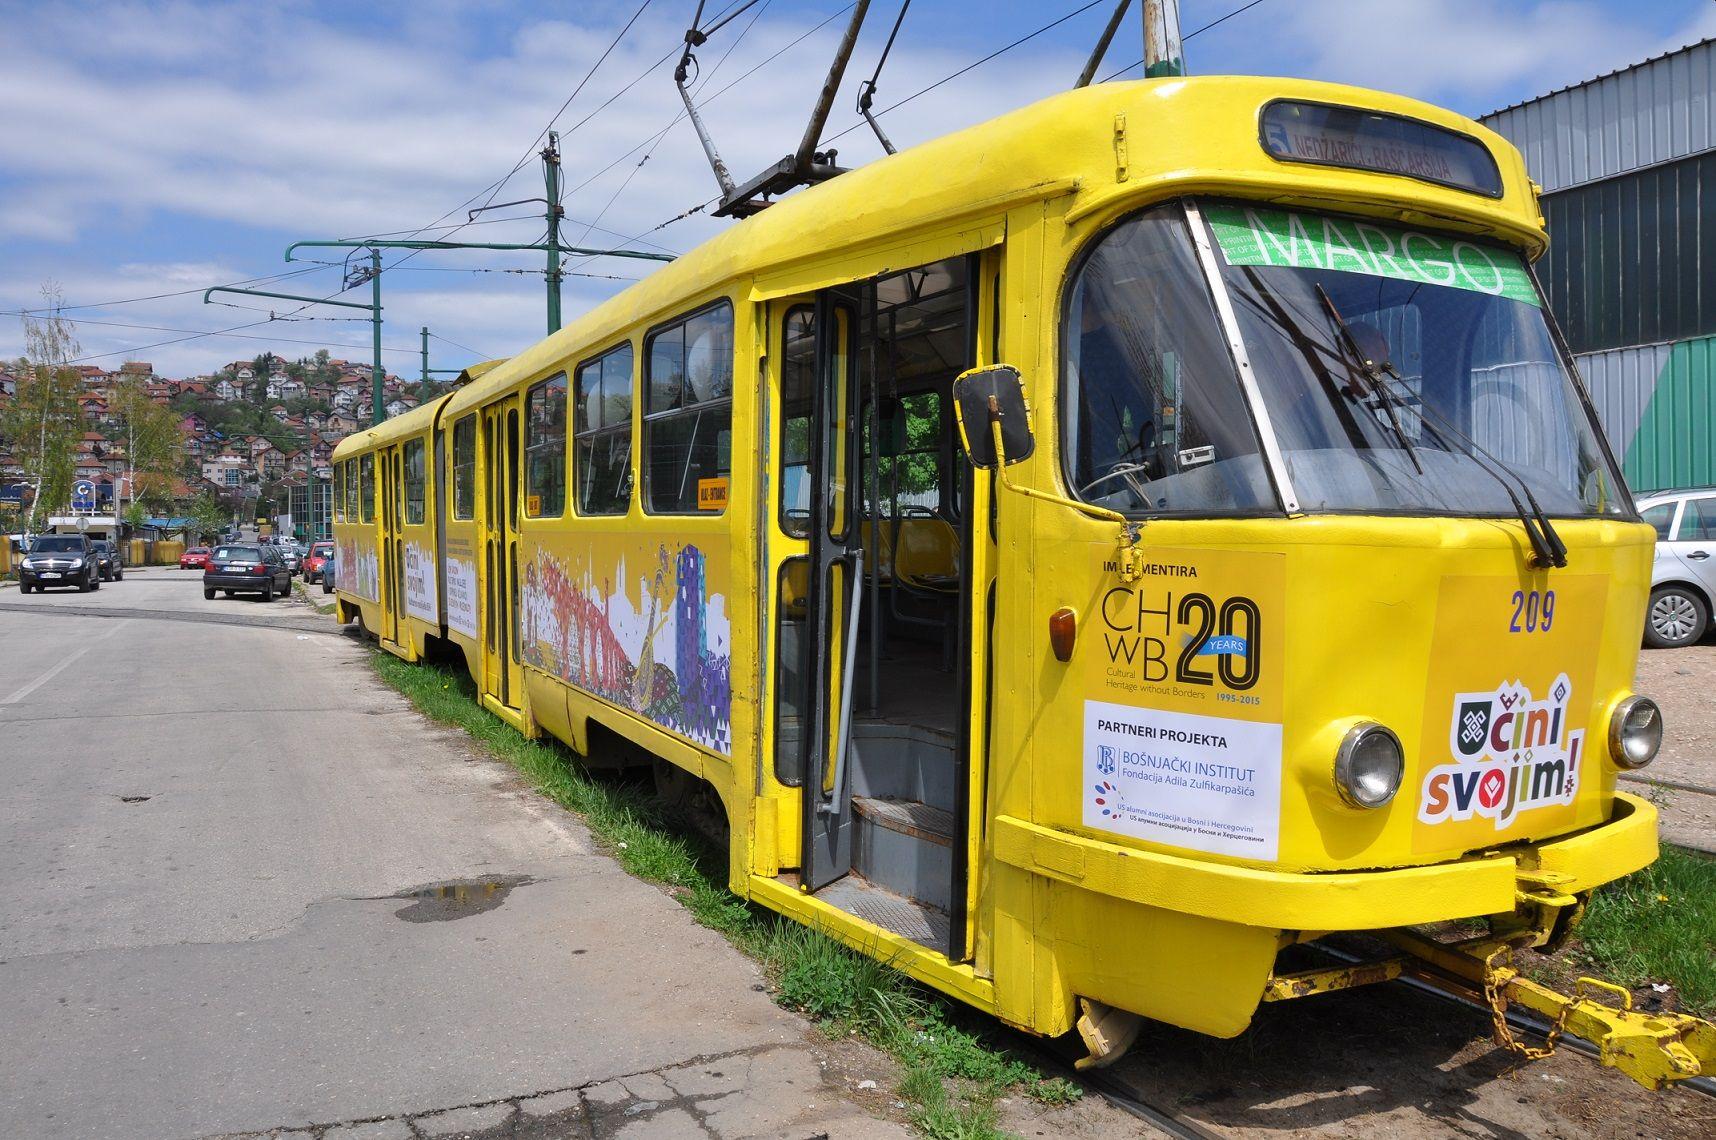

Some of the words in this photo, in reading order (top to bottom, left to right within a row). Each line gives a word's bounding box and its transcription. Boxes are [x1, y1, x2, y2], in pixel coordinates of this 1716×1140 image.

[1243, 208, 1505, 296] MARGO
[1102, 586, 1172, 636] CH
[1509, 590, 1556, 634] 209
[1104, 632, 1170, 682] WB
[1175, 592, 1262, 691] 20
[1209, 639, 1244, 652] YEARS
[1106, 666, 1136, 679] Cultural
[1106, 678, 1139, 692] Heritage
[1140, 684, 1171, 697] without
[1172, 686, 1206, 700] Borders
[1216, 692, 1261, 706] 1995-2015
[1097, 719, 1157, 739] PARTNERI
[1159, 728, 1228, 748] PROJEKTA
[1122, 750, 1191, 774] BOŠNJAČKI
[1195, 762, 1256, 782] INSTITUT
[1425, 737, 1581, 822] svojim!
[1122, 767, 1163, 784] Fondacija
[1165, 774, 1188, 788] Adila
[1189, 778, 1256, 797] Zulfikarpašića
[1117, 803, 1126, 811] US
[1126, 805, 1147, 815] alumni
[1148, 810, 1181, 822] asocijacija
[1187, 816, 1206, 826] Bosni
[1211, 820, 1254, 833] Hercegovini
